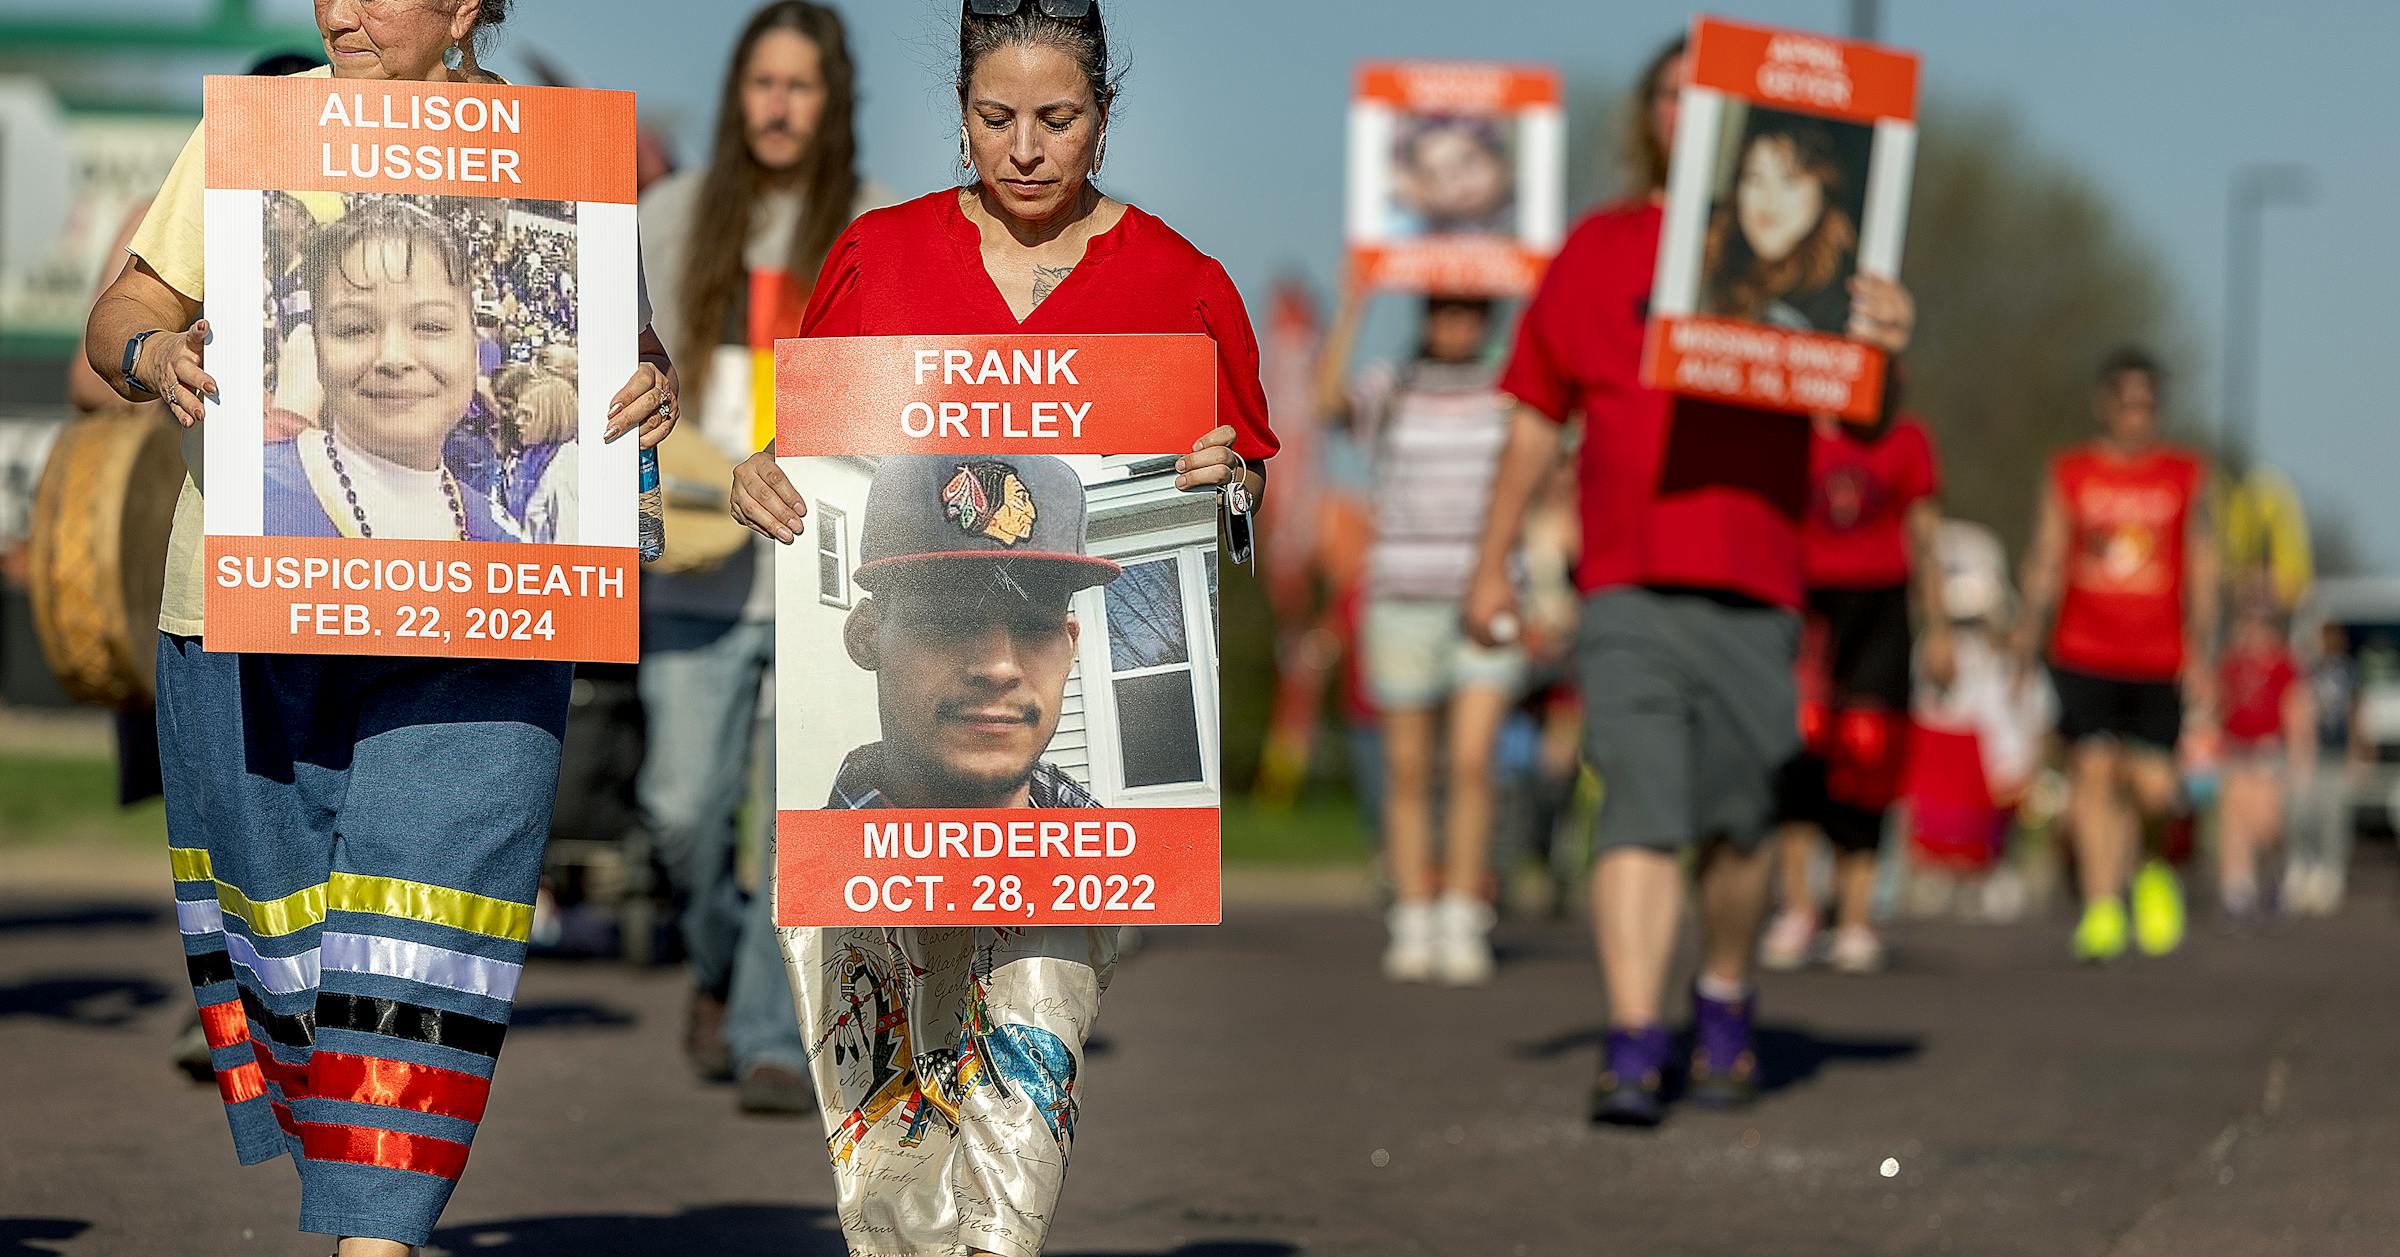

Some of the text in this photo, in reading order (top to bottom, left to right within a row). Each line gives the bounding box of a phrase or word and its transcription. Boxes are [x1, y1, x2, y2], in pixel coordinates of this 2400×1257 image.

[317, 92, 520, 134] ALLISON
[322, 142, 522, 184] LUSSIER
[912, 349, 1080, 385] FRANK
[899, 401, 1093, 438] ORTLEY
[216, 555, 624, 598] SUSPICIOUS DEATH
[290, 603, 556, 644] FEB. 22, 2024
[863, 821, 1136, 859] MURDERED
[843, 874, 1156, 918] OCT. 28, 2022
